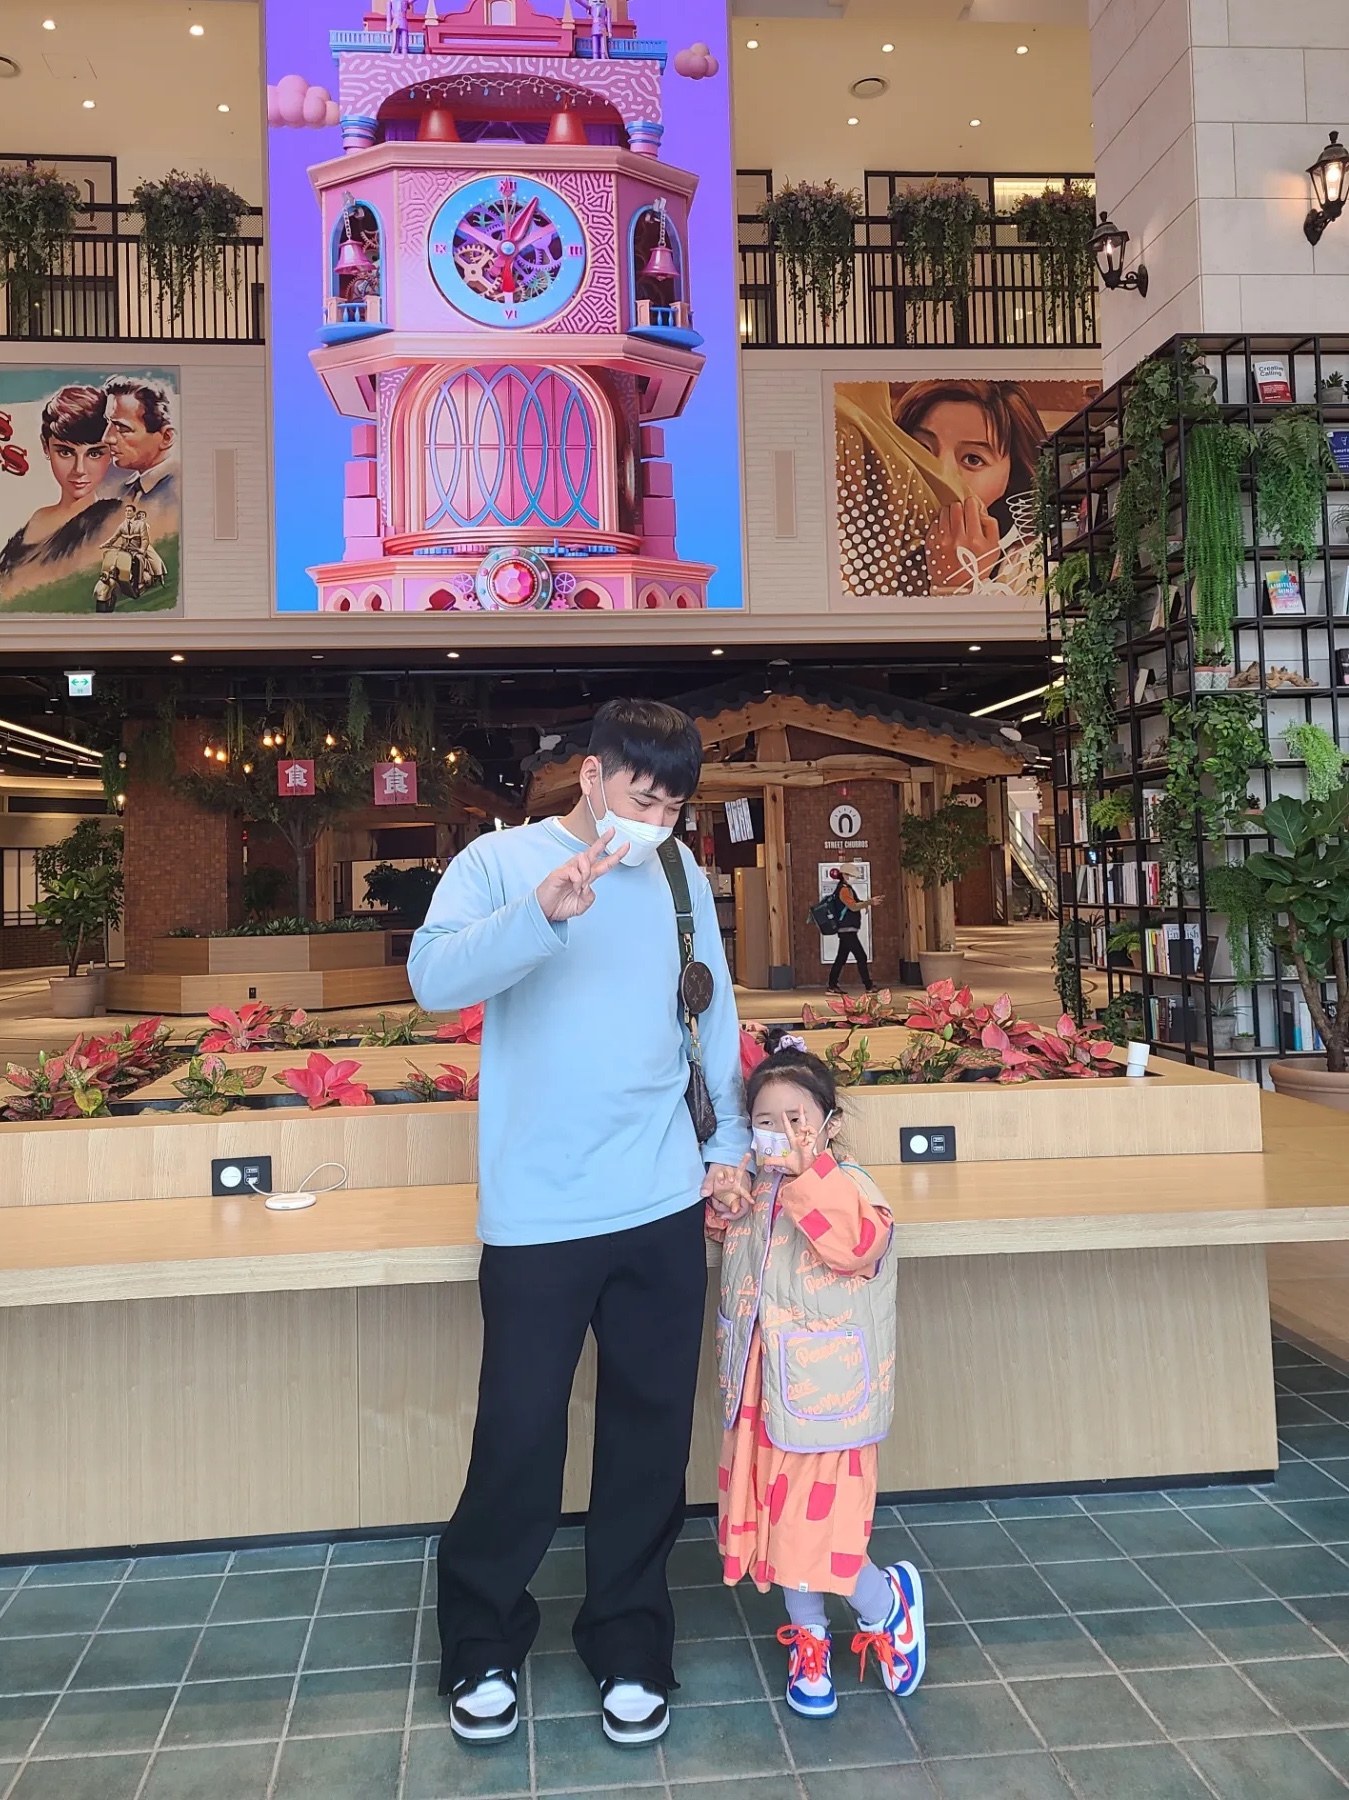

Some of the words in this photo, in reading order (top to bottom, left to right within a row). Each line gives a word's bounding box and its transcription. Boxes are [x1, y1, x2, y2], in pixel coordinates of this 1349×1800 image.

[284, 764, 308, 787] 食
[381, 767, 409, 795] 食
[824, 841, 843, 849] STREET
[1167, 929, 1199, 939] Enish
